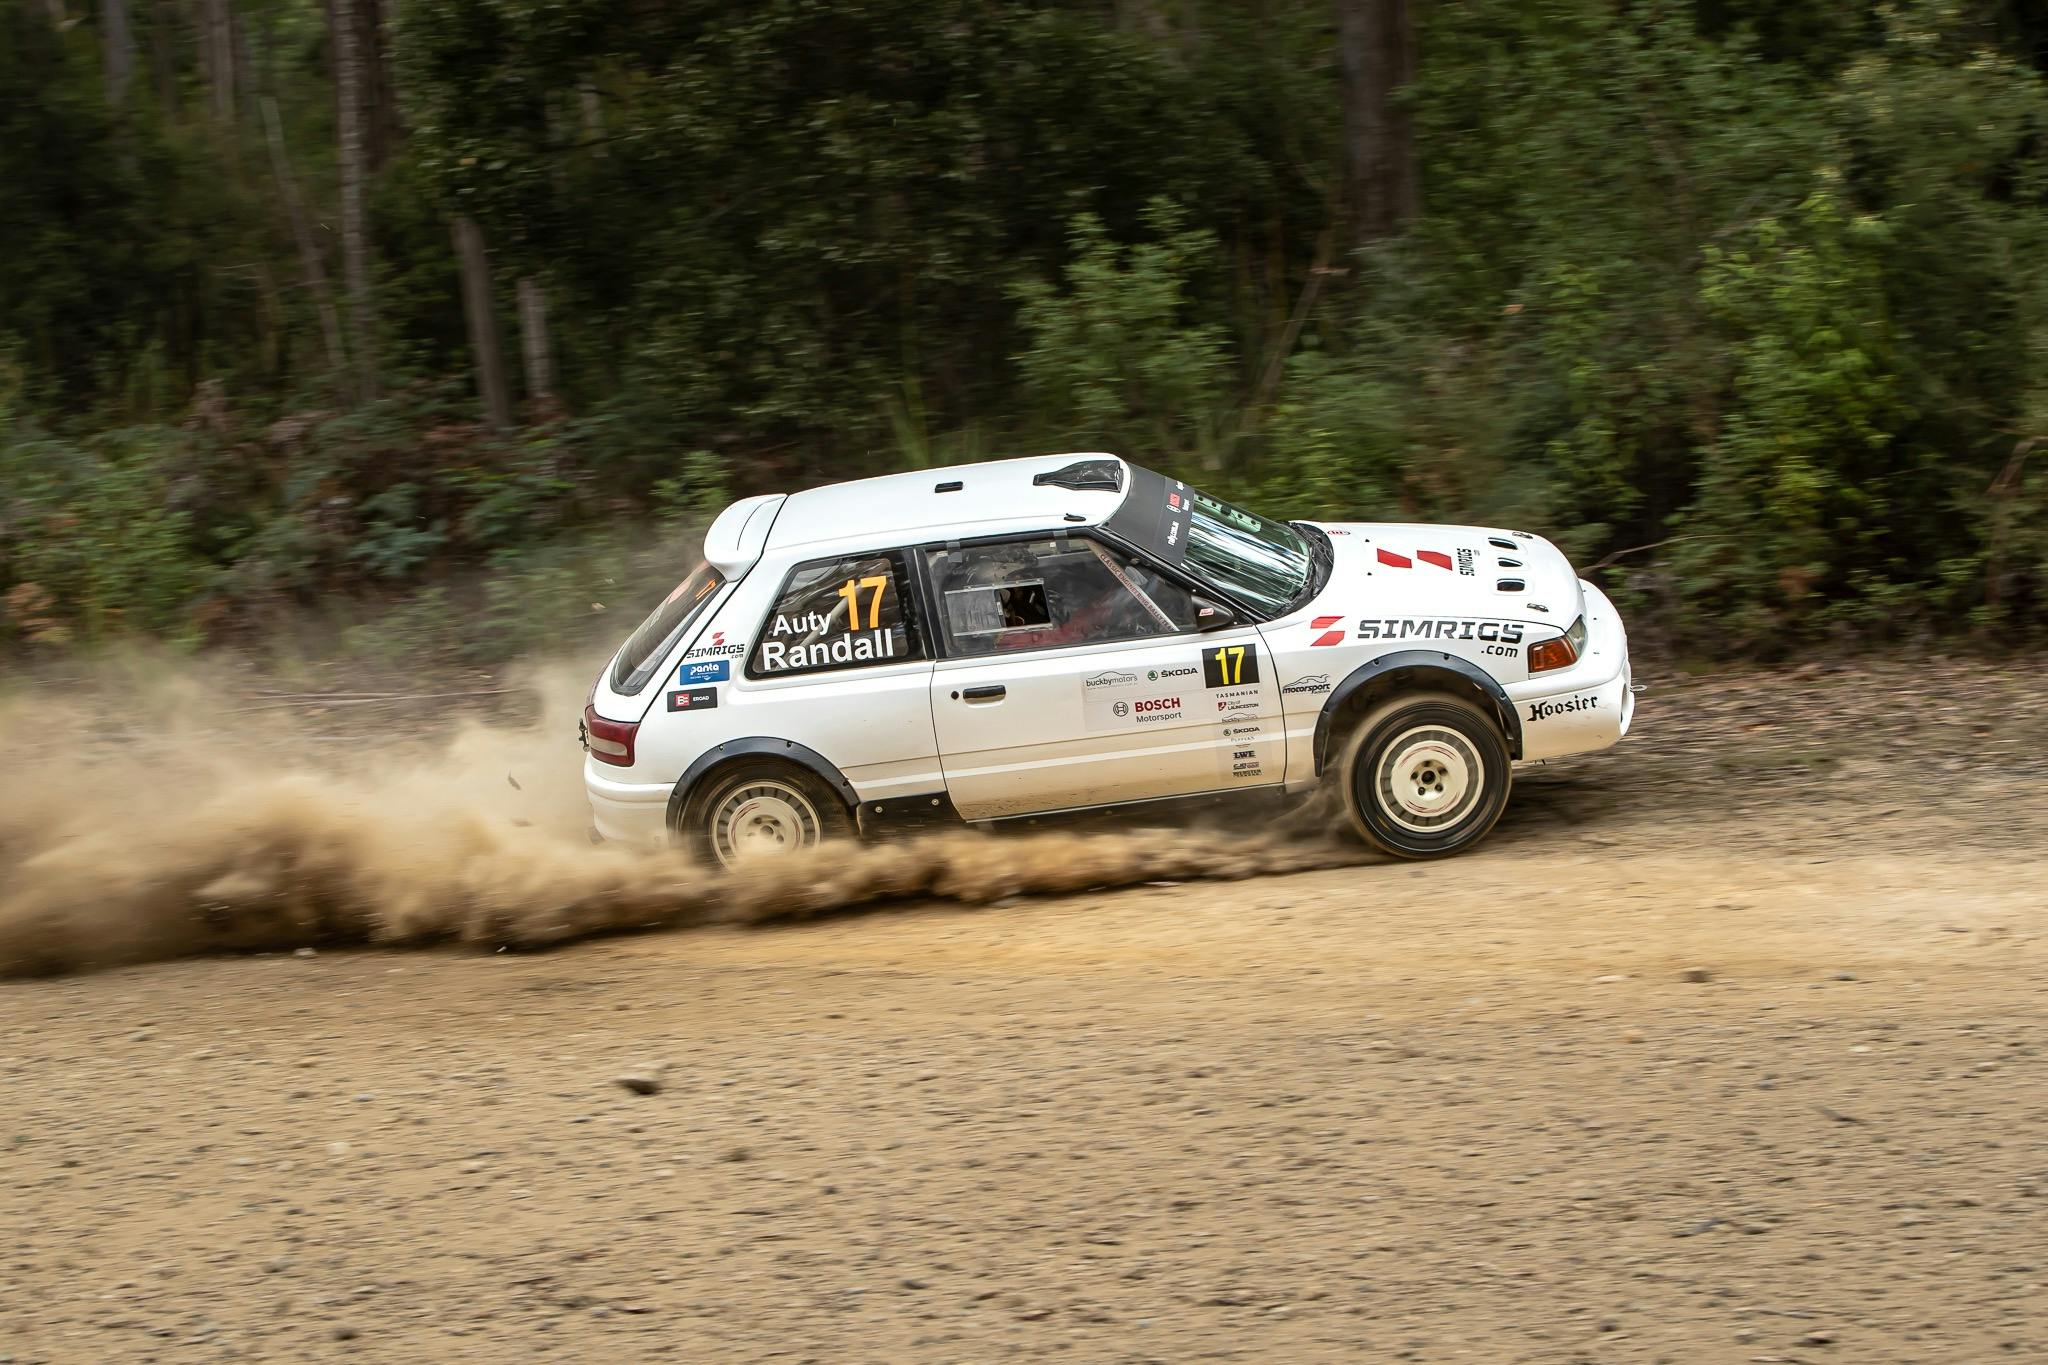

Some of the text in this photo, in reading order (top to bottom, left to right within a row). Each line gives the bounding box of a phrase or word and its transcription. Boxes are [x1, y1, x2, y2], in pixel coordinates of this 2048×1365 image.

[1100, 553, 1121, 576] CLASSIC
[838, 575, 887, 631] 17
[773, 611, 832, 637] Auty
[1357, 619, 1524, 644] SIMRIGS
[686, 644, 745, 659] SIMRIGS
[762, 628, 894, 671] Randall
[1480, 644, 1518, 658] .com
[690, 663, 719, 676] panta
[1160, 667, 1198, 678] ŠKODA
[1215, 646, 1245, 685] 17
[1086, 675, 1138, 688] buckbymotors
[1282, 683, 1331, 694] motorsport
[1215, 689, 1259, 698] TASMANIAN
[1134, 697, 1181, 713] BOSCH
[1526, 694, 1598, 722] Hoosier
[1136, 712, 1182, 723] Motorsport
